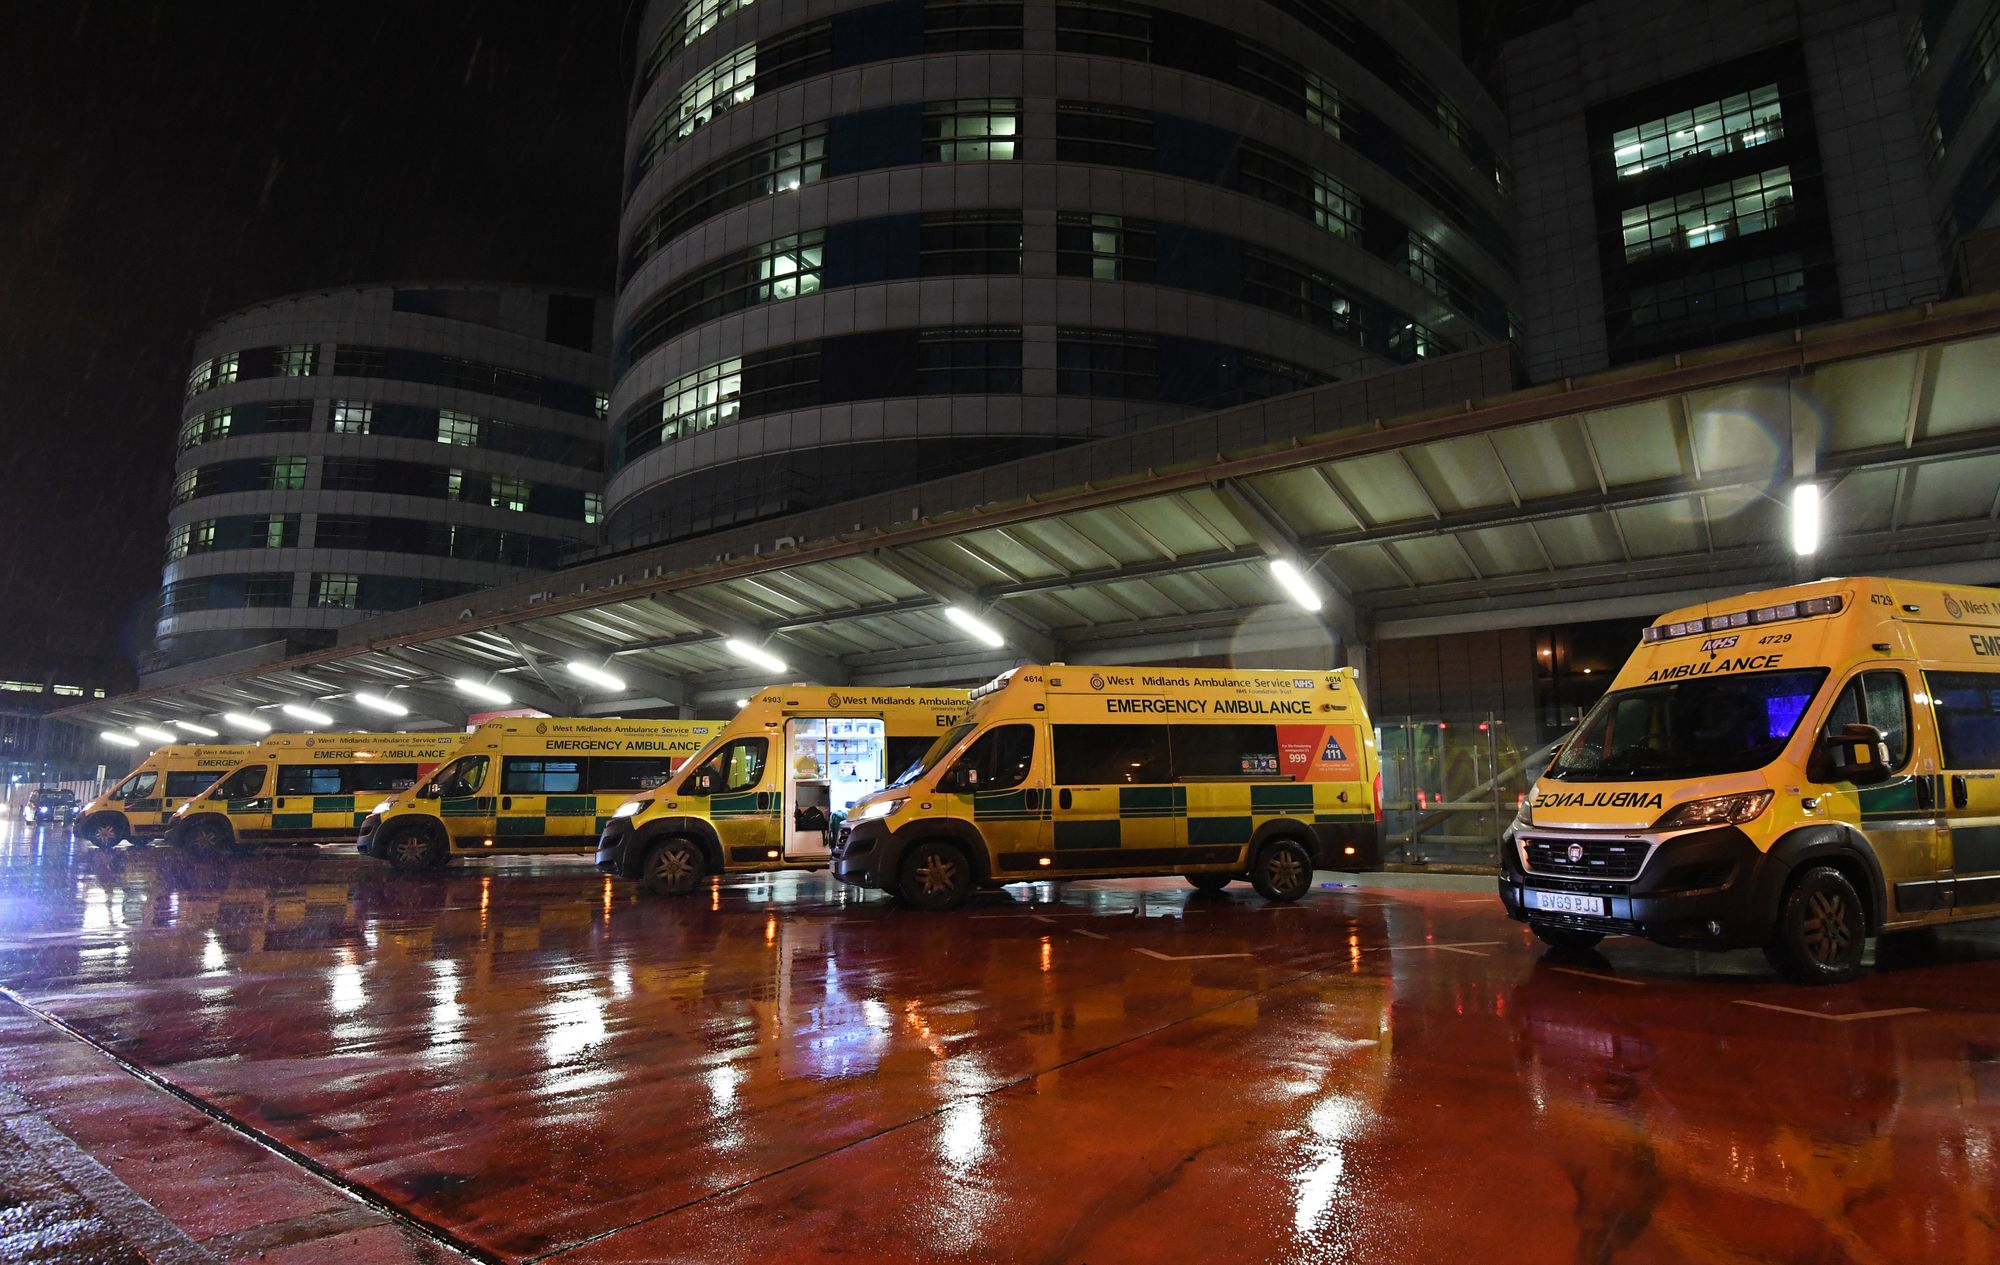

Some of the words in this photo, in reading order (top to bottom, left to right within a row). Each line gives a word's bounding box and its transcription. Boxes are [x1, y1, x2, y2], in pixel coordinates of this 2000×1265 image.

[1870, 594, 1894, 606] 4729
[1960, 600, 1992, 615] West
[1700, 635, 1740, 651] NHS
[1758, 634, 1792, 645] 4729
[1645, 654, 1783, 683] AMBULANCE
[1023, 675, 1043, 683] 4614
[1107, 675, 1134, 686] West
[1142, 676, 1190, 687] Midlands
[1194, 677, 1251, 688] Ambulance
[1254, 679, 1291, 688] Service
[1293, 679, 1314, 688] NHS
[842, 696, 867, 705] West
[872, 696, 916, 705] Midlands
[919, 697, 973, 706] Ambulance
[1107, 699, 1207, 713] EMERGENCY
[1214, 700, 1312, 714] AMBULANCE
[552, 724, 573, 732] West
[576, 724, 612, 733] Midlands
[615, 725, 659, 734] Ambulance
[661, 726, 689, 734] Service
[546, 740, 622, 750] EMERGENCY
[626, 741, 701, 751] AMBULANCE
[380, 750, 445, 758] AMBULANCE
[1289, 753, 1306, 763] 999
[1326, 749, 1341, 759] 111
[198, 759, 243, 767] EMERGEN
